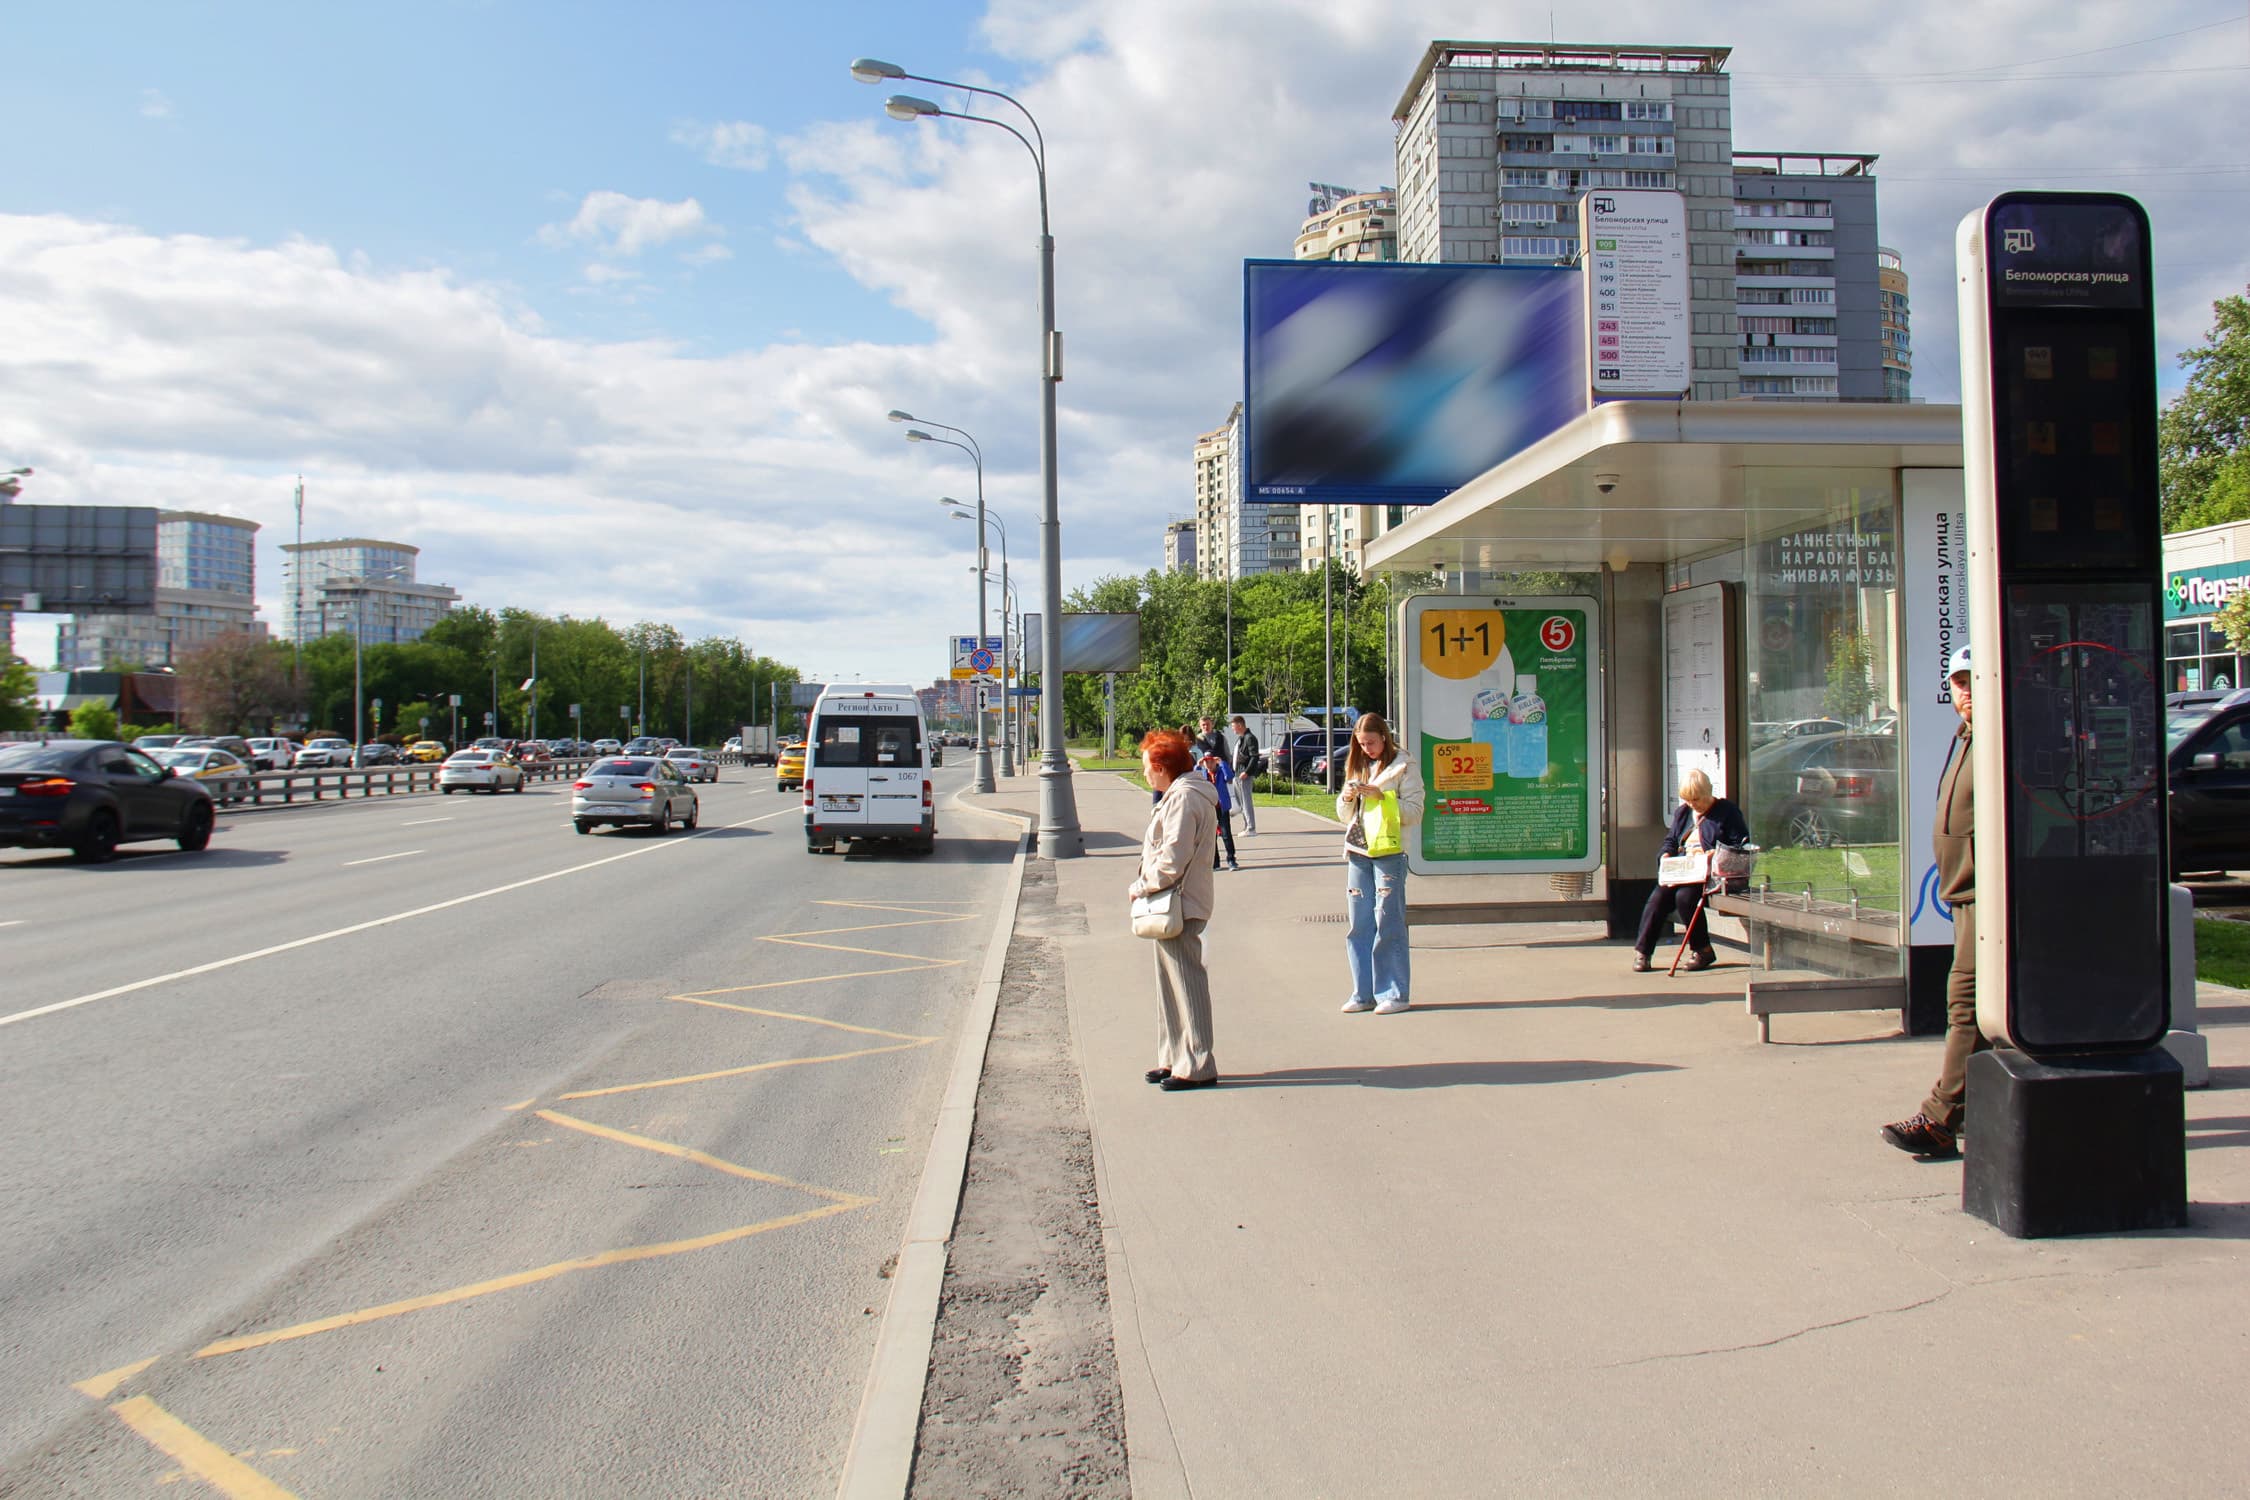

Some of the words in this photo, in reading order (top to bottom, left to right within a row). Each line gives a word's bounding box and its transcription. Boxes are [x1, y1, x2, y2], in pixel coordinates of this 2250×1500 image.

[1595, 216, 1644, 224] Беломорская
[2005, 269, 2088, 283] Беломорская
[2091, 272, 2129, 284] улица
[1600, 322, 1616, 330] 243
[1601, 352, 1617, 360] 500
[1955, 512, 1964, 545] Ulitsa
[1936, 512, 1952, 569] улица
[1782, 552, 1856, 565] КАРАОКЕ
[1868, 552, 1895, 565] БА
[1782, 569, 1840, 582] ЖИВАЯ
[1955, 550, 1968, 634] Belomorskaya
[1430, 622, 1489, 656] 1+1
[838, 703, 868, 712] Регион
[871, 704, 892, 712] Авто
[1438, 746, 1452, 756] 65
[1452, 757, 1474, 774] 32
[898, 773, 918, 781] 1067
